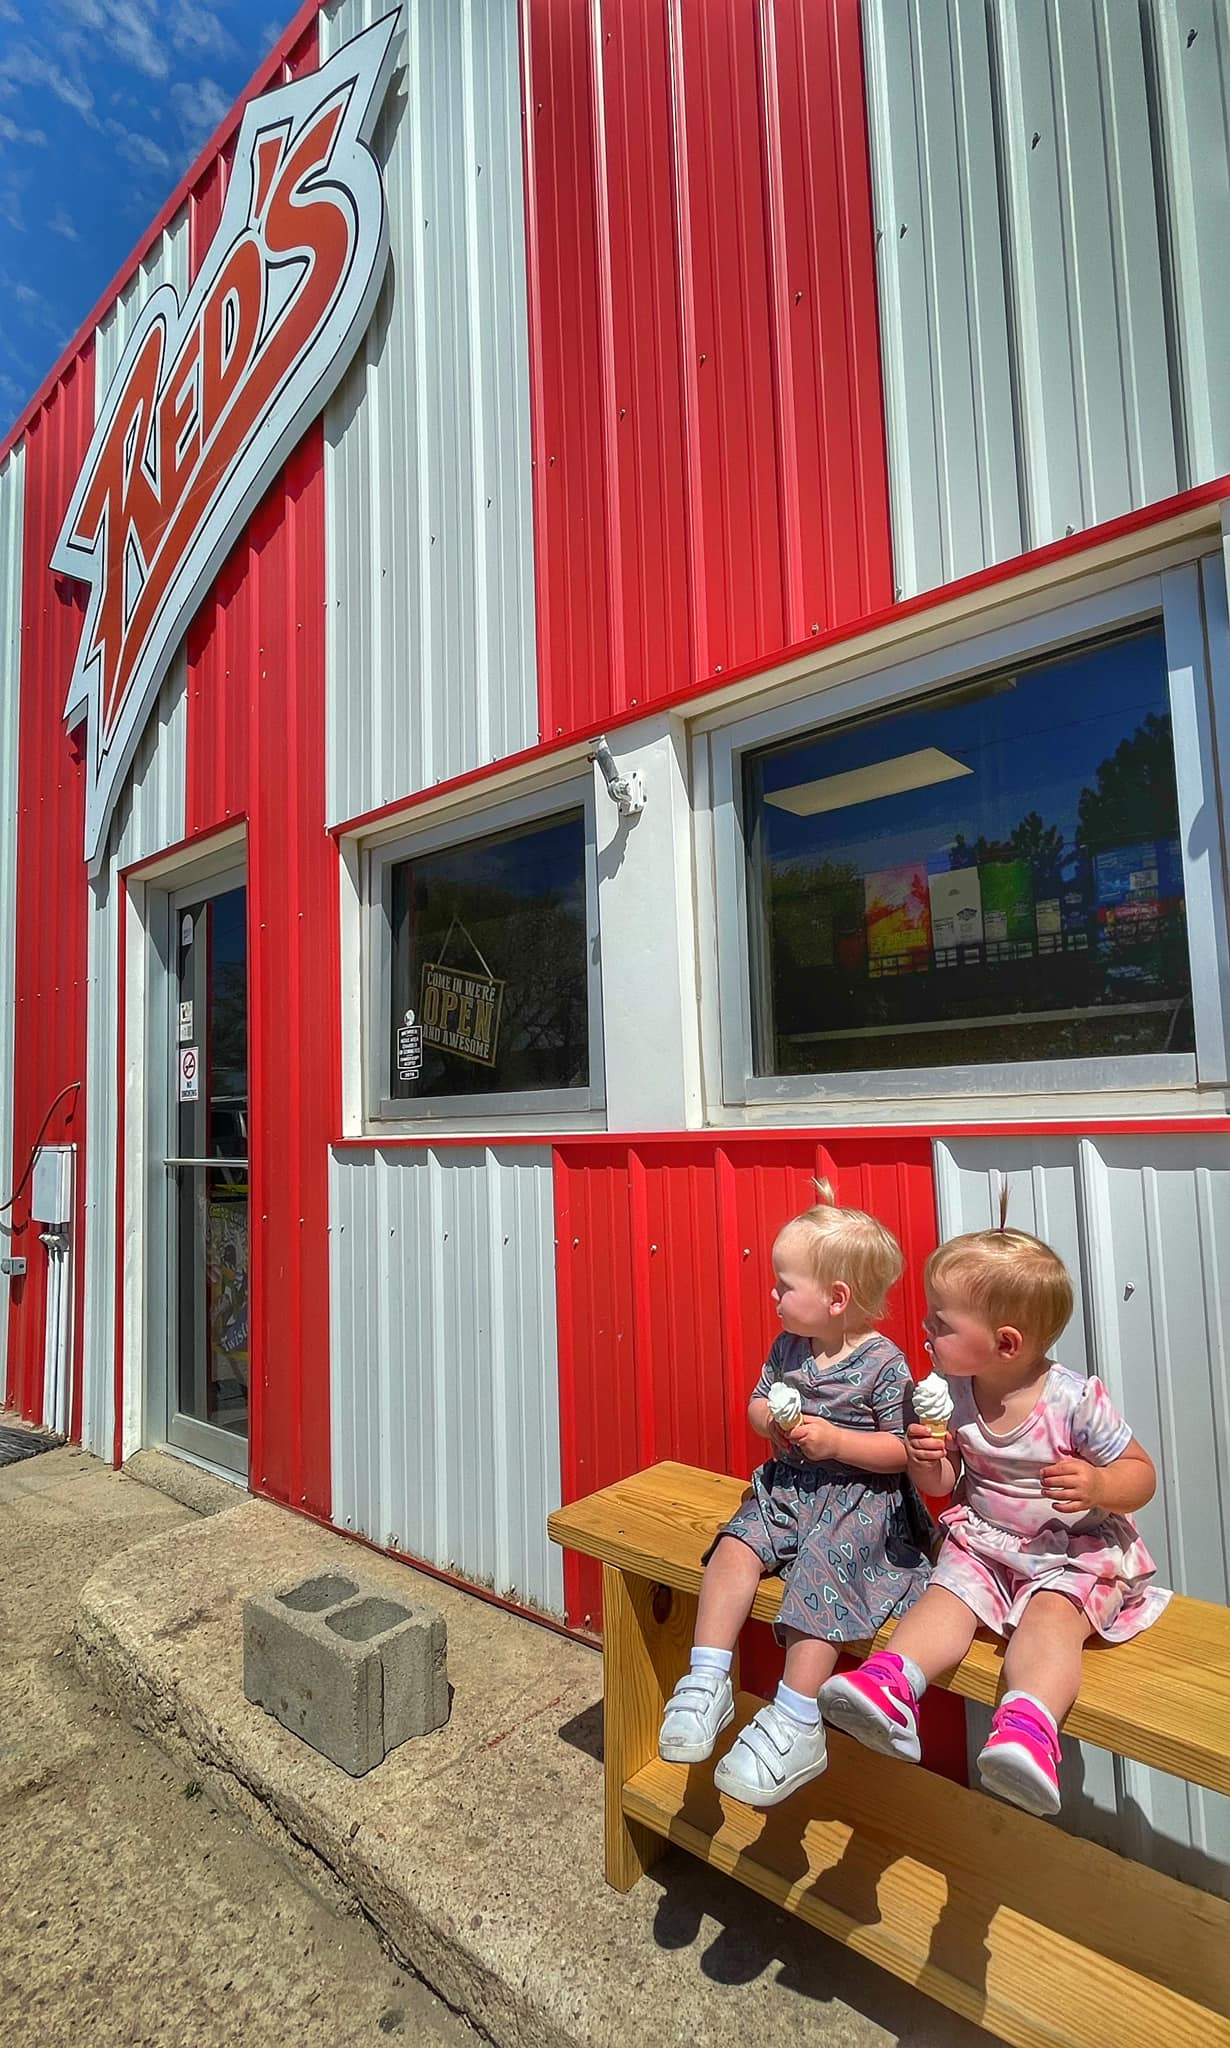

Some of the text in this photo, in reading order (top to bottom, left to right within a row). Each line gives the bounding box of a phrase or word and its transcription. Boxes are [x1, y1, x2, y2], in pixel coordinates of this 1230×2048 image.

[68, 80, 357, 752] RED'S
[427, 971, 452, 990] COME
[453, 978, 462, 994] IN
[424, 986, 494, 1042] OPEN
[423, 1024, 490, 1059] AND AWESOME
[220, 1321, 249, 1352] Twist
